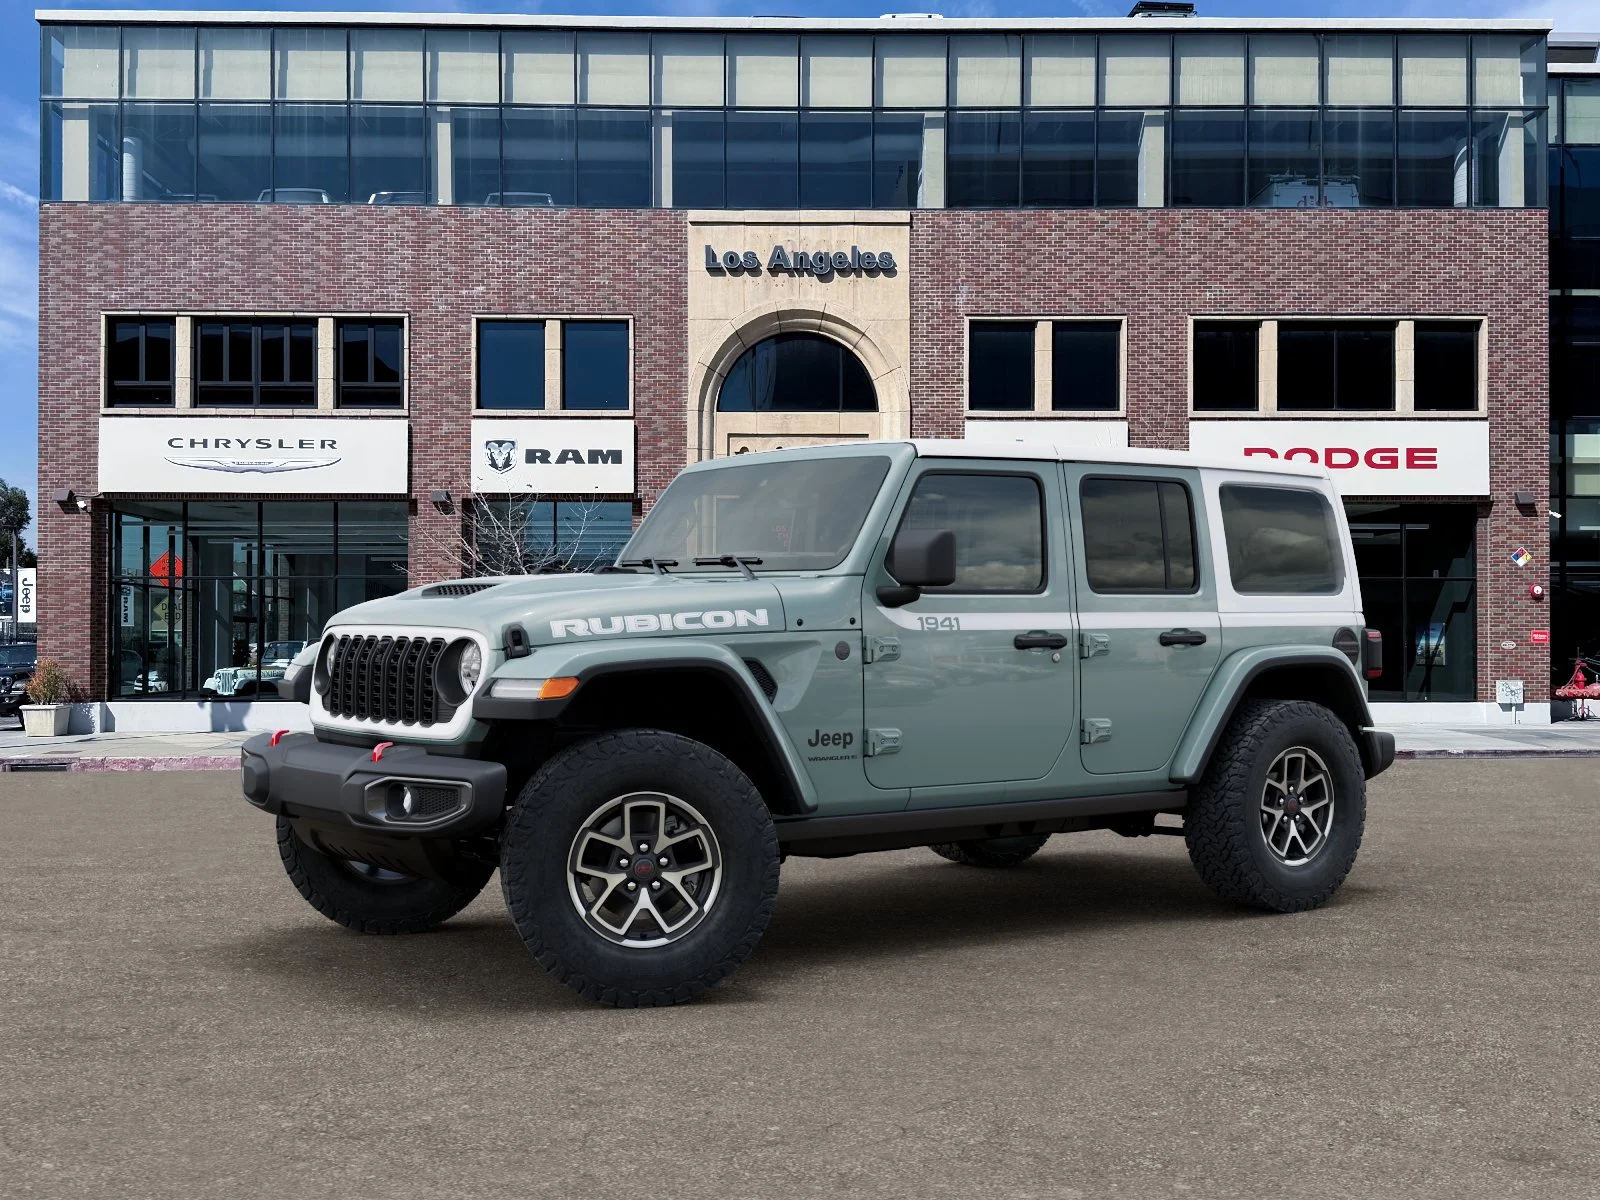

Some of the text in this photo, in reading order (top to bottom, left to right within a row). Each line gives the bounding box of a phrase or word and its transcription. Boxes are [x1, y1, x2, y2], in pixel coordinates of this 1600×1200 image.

[704, 244, 895, 276] Los Angeles
[167, 437, 338, 450] CHRYSLER
[525, 448, 623, 465] RAM
[20, 577, 34, 614] Jeep
[550, 608, 769, 638] RUBICON
[916, 616, 961, 631] 1941
[807, 729, 854, 749] Jeep
